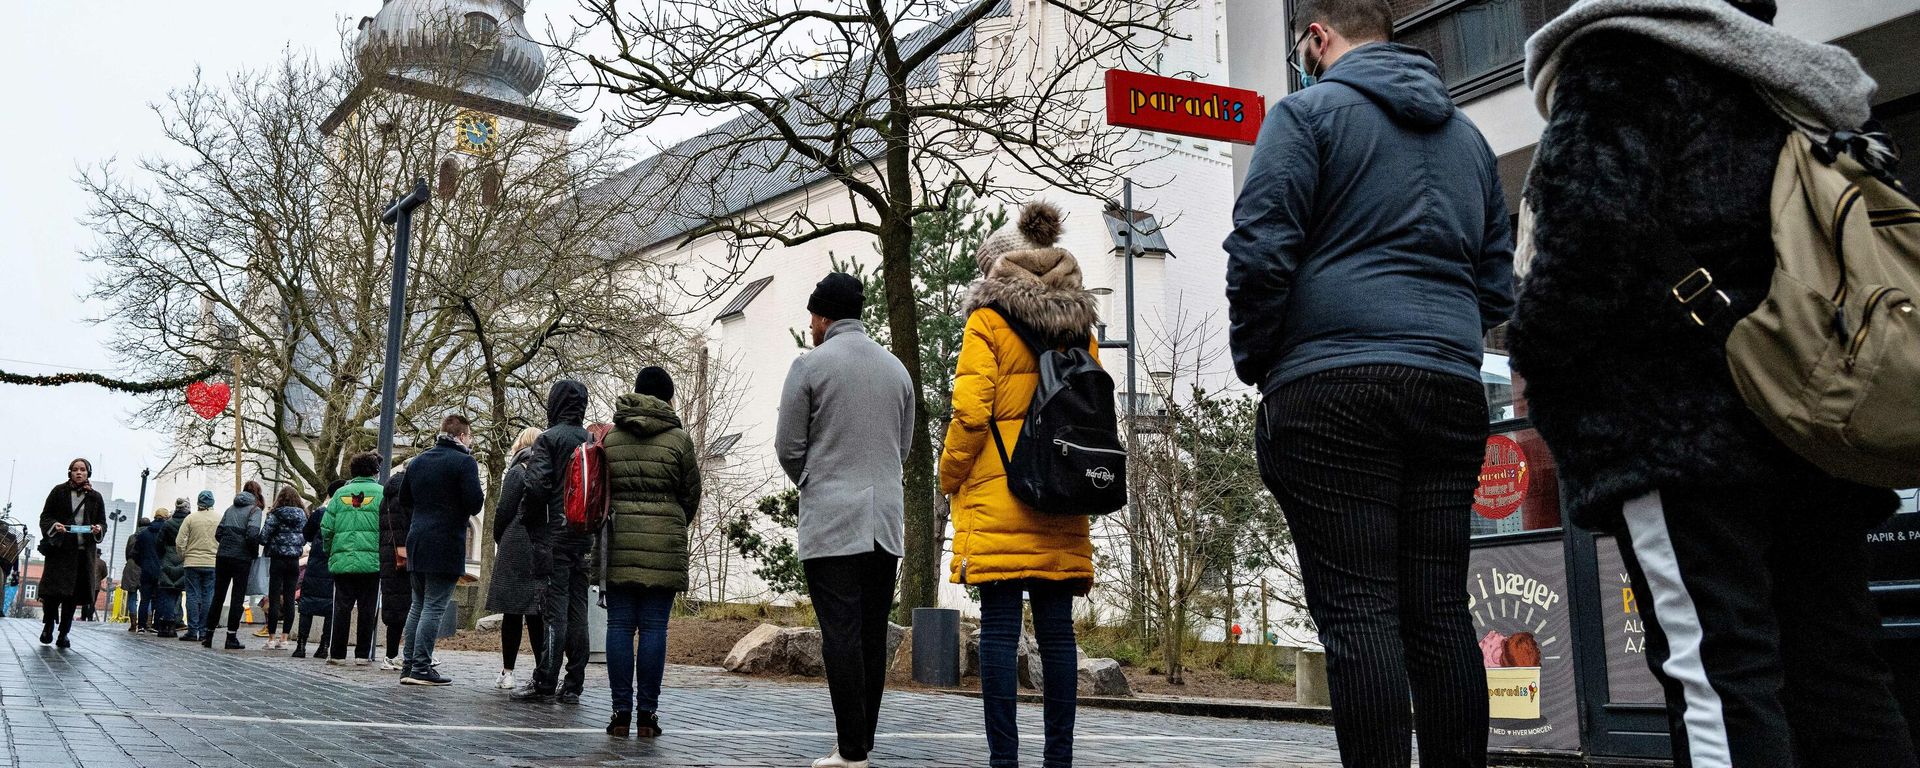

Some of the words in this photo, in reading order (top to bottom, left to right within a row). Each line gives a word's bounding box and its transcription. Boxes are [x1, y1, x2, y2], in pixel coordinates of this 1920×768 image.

[1130, 88, 1244, 123] paradis
[1085, 468, 1102, 479] Hard
[1867, 532, 1895, 542] PAPIR
[1898, 531, 1905, 541] &
[1476, 573, 1488, 600] i
[1492, 568, 1559, 611] bæger
[1527, 723, 1552, 735] MORGEN
